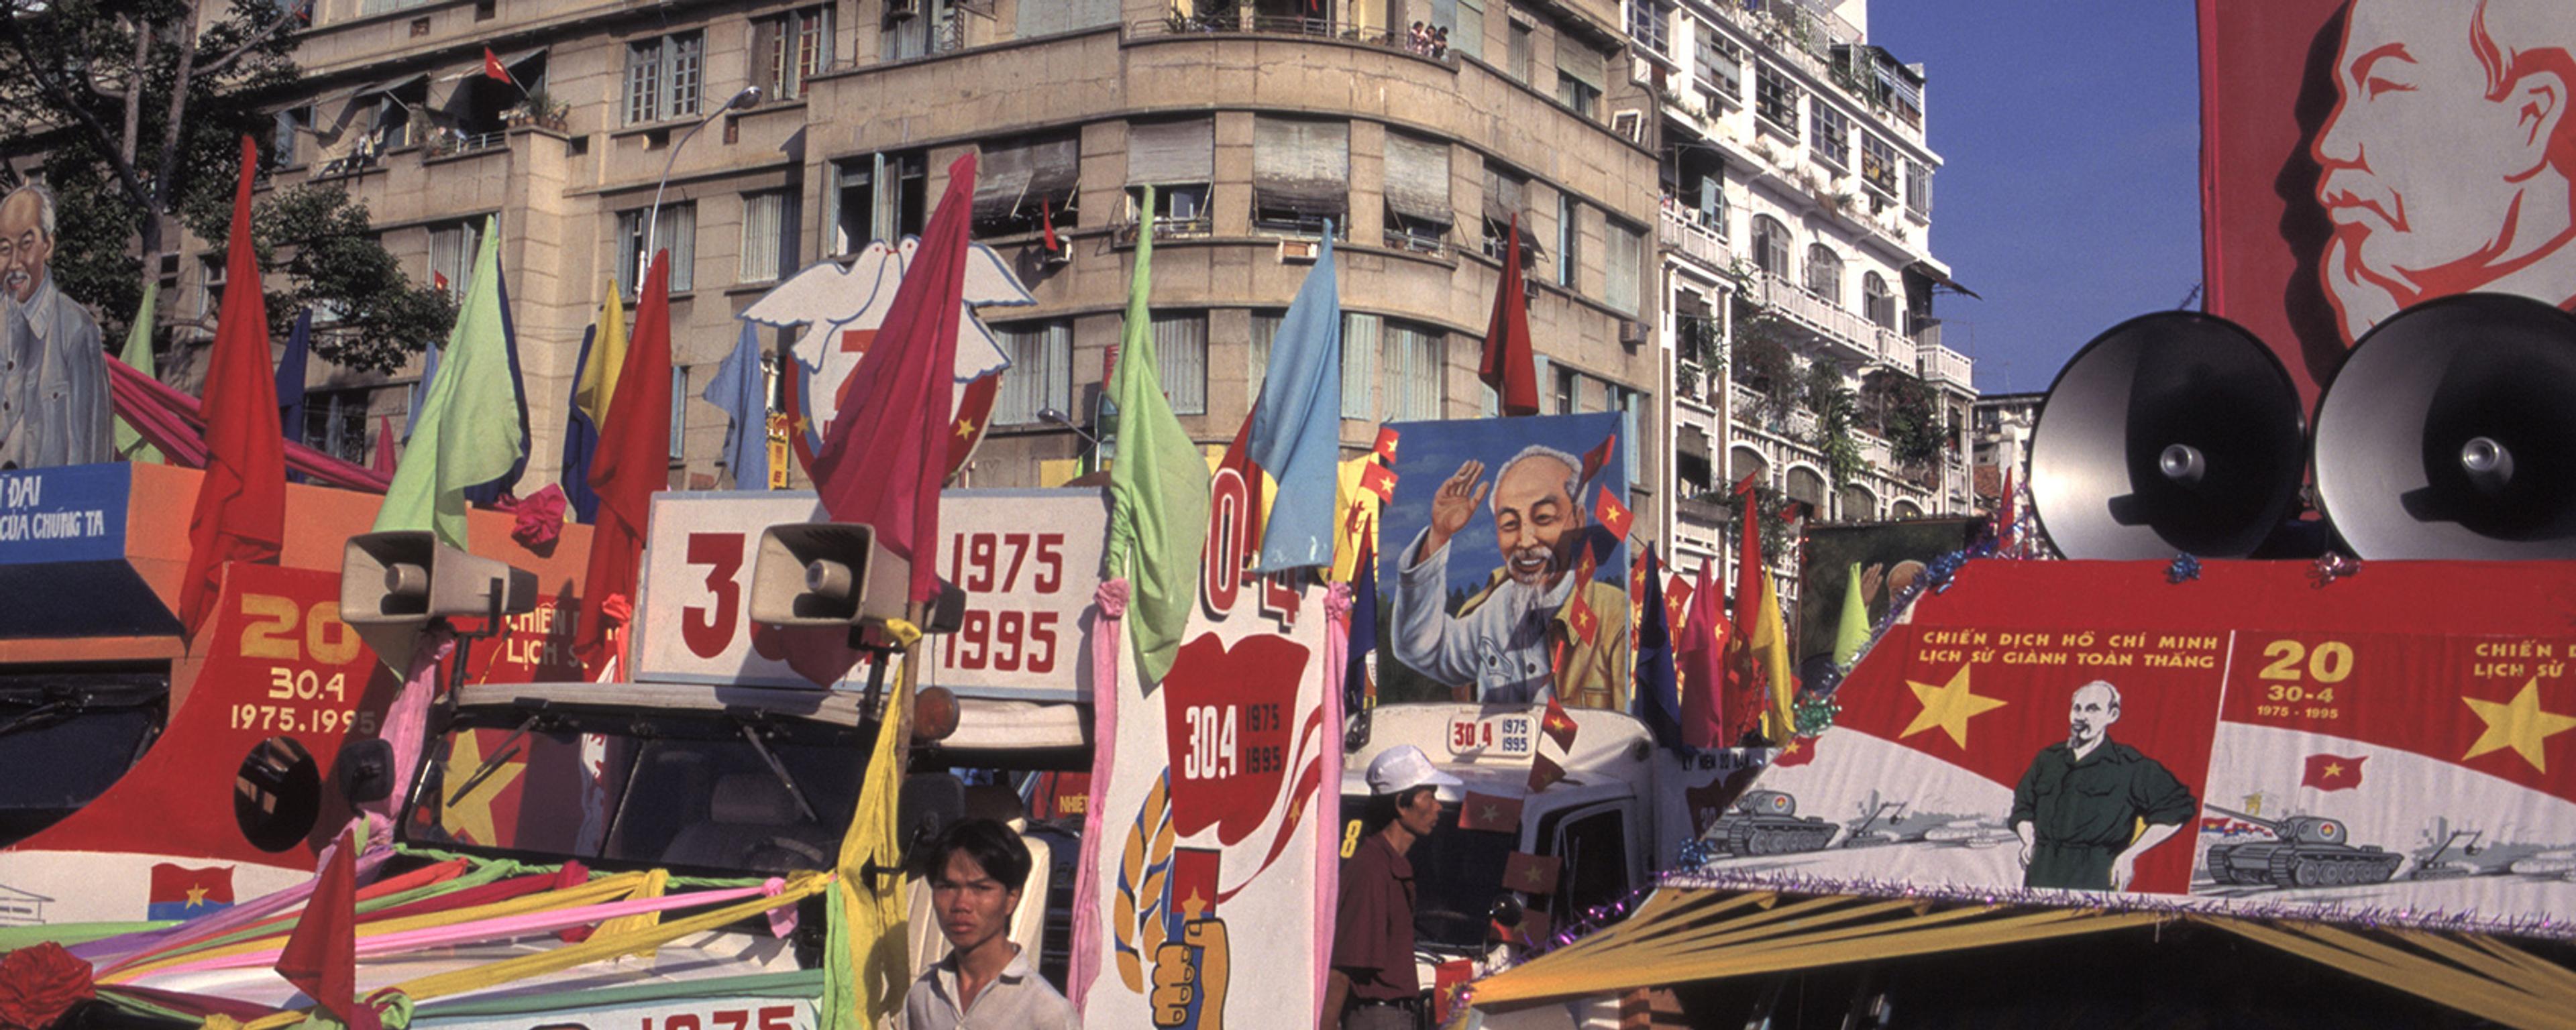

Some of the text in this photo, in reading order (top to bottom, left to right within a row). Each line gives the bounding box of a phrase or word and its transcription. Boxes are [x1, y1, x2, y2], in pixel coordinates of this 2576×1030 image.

[8, 475, 42, 511] ĐẠI
[33, 506, 82, 538] CHÚNG
[85, 510, 104, 536] TA
[952, 533, 1064, 593] 1975
[240, 593, 361, 665] 20
[945, 610, 1058, 673] 1995
[1923, 628, 2218, 650] CHIẾN DỊCH HỒ CHÍ MINH
[508, 638, 557, 671] LỊCH
[1919, 646, 2214, 668] LỊCH SỬ GIÀNH TOÀN THẮNG
[2259, 639, 2354, 683] 20
[2475, 638, 2553, 657] CHIẾN
[2474, 659, 2565, 679] LỊCH SỬ
[269, 667, 345, 702] 30.4
[2267, 685, 2334, 703] 30-4
[1245, 704, 1279, 732] 1975
[1503, 719, 1527, 734] 1975
[2257, 705, 2289, 718] 1975
[2306, 707, 2339, 720] 1995
[1185, 705, 1237, 780] 30.4
[1503, 737, 1527, 752] 1995
[1245, 746, 1281, 775] 1995
